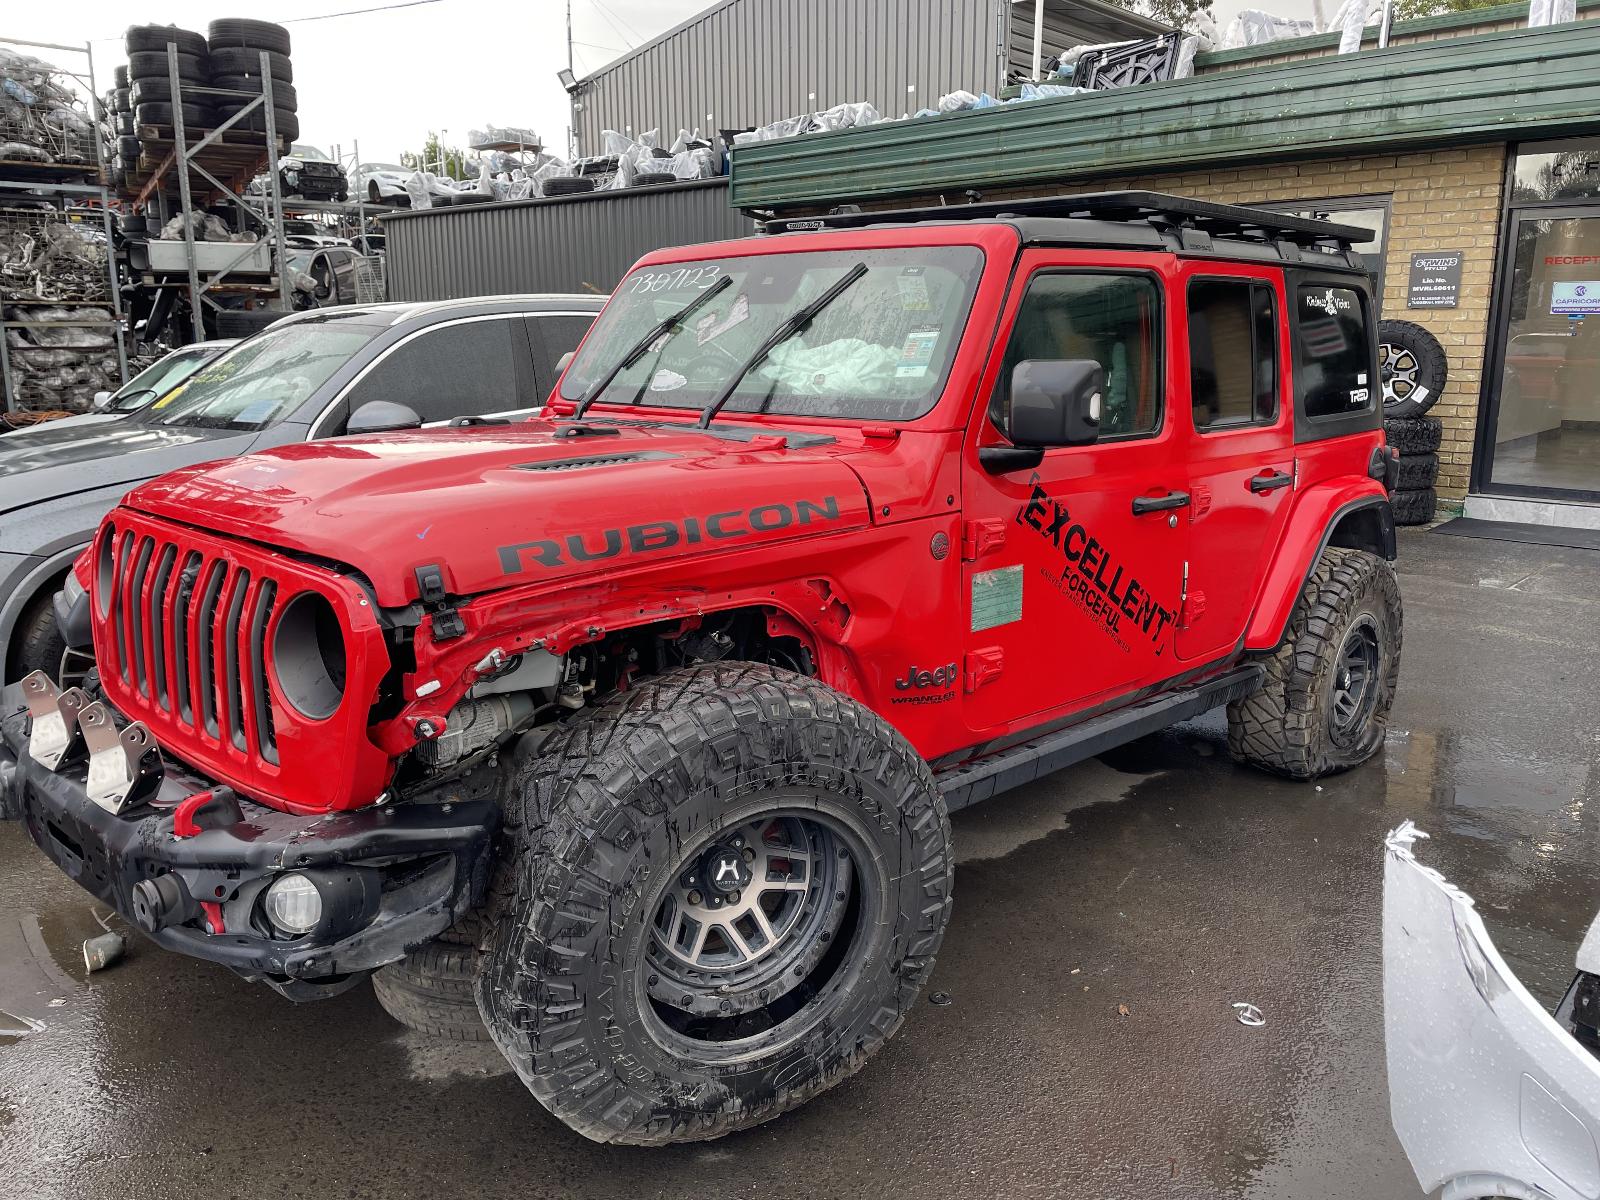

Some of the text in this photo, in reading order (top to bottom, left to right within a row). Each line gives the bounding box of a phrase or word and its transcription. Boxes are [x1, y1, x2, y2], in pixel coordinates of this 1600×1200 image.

[496, 495, 840, 575] RUBICON
[1022, 484, 1172, 642] EXCELLENT
[1061, 565, 1120, 634] FORCEFUL
[890, 691, 955, 704] WRANGLER
[895, 662, 958, 690] Jeep
